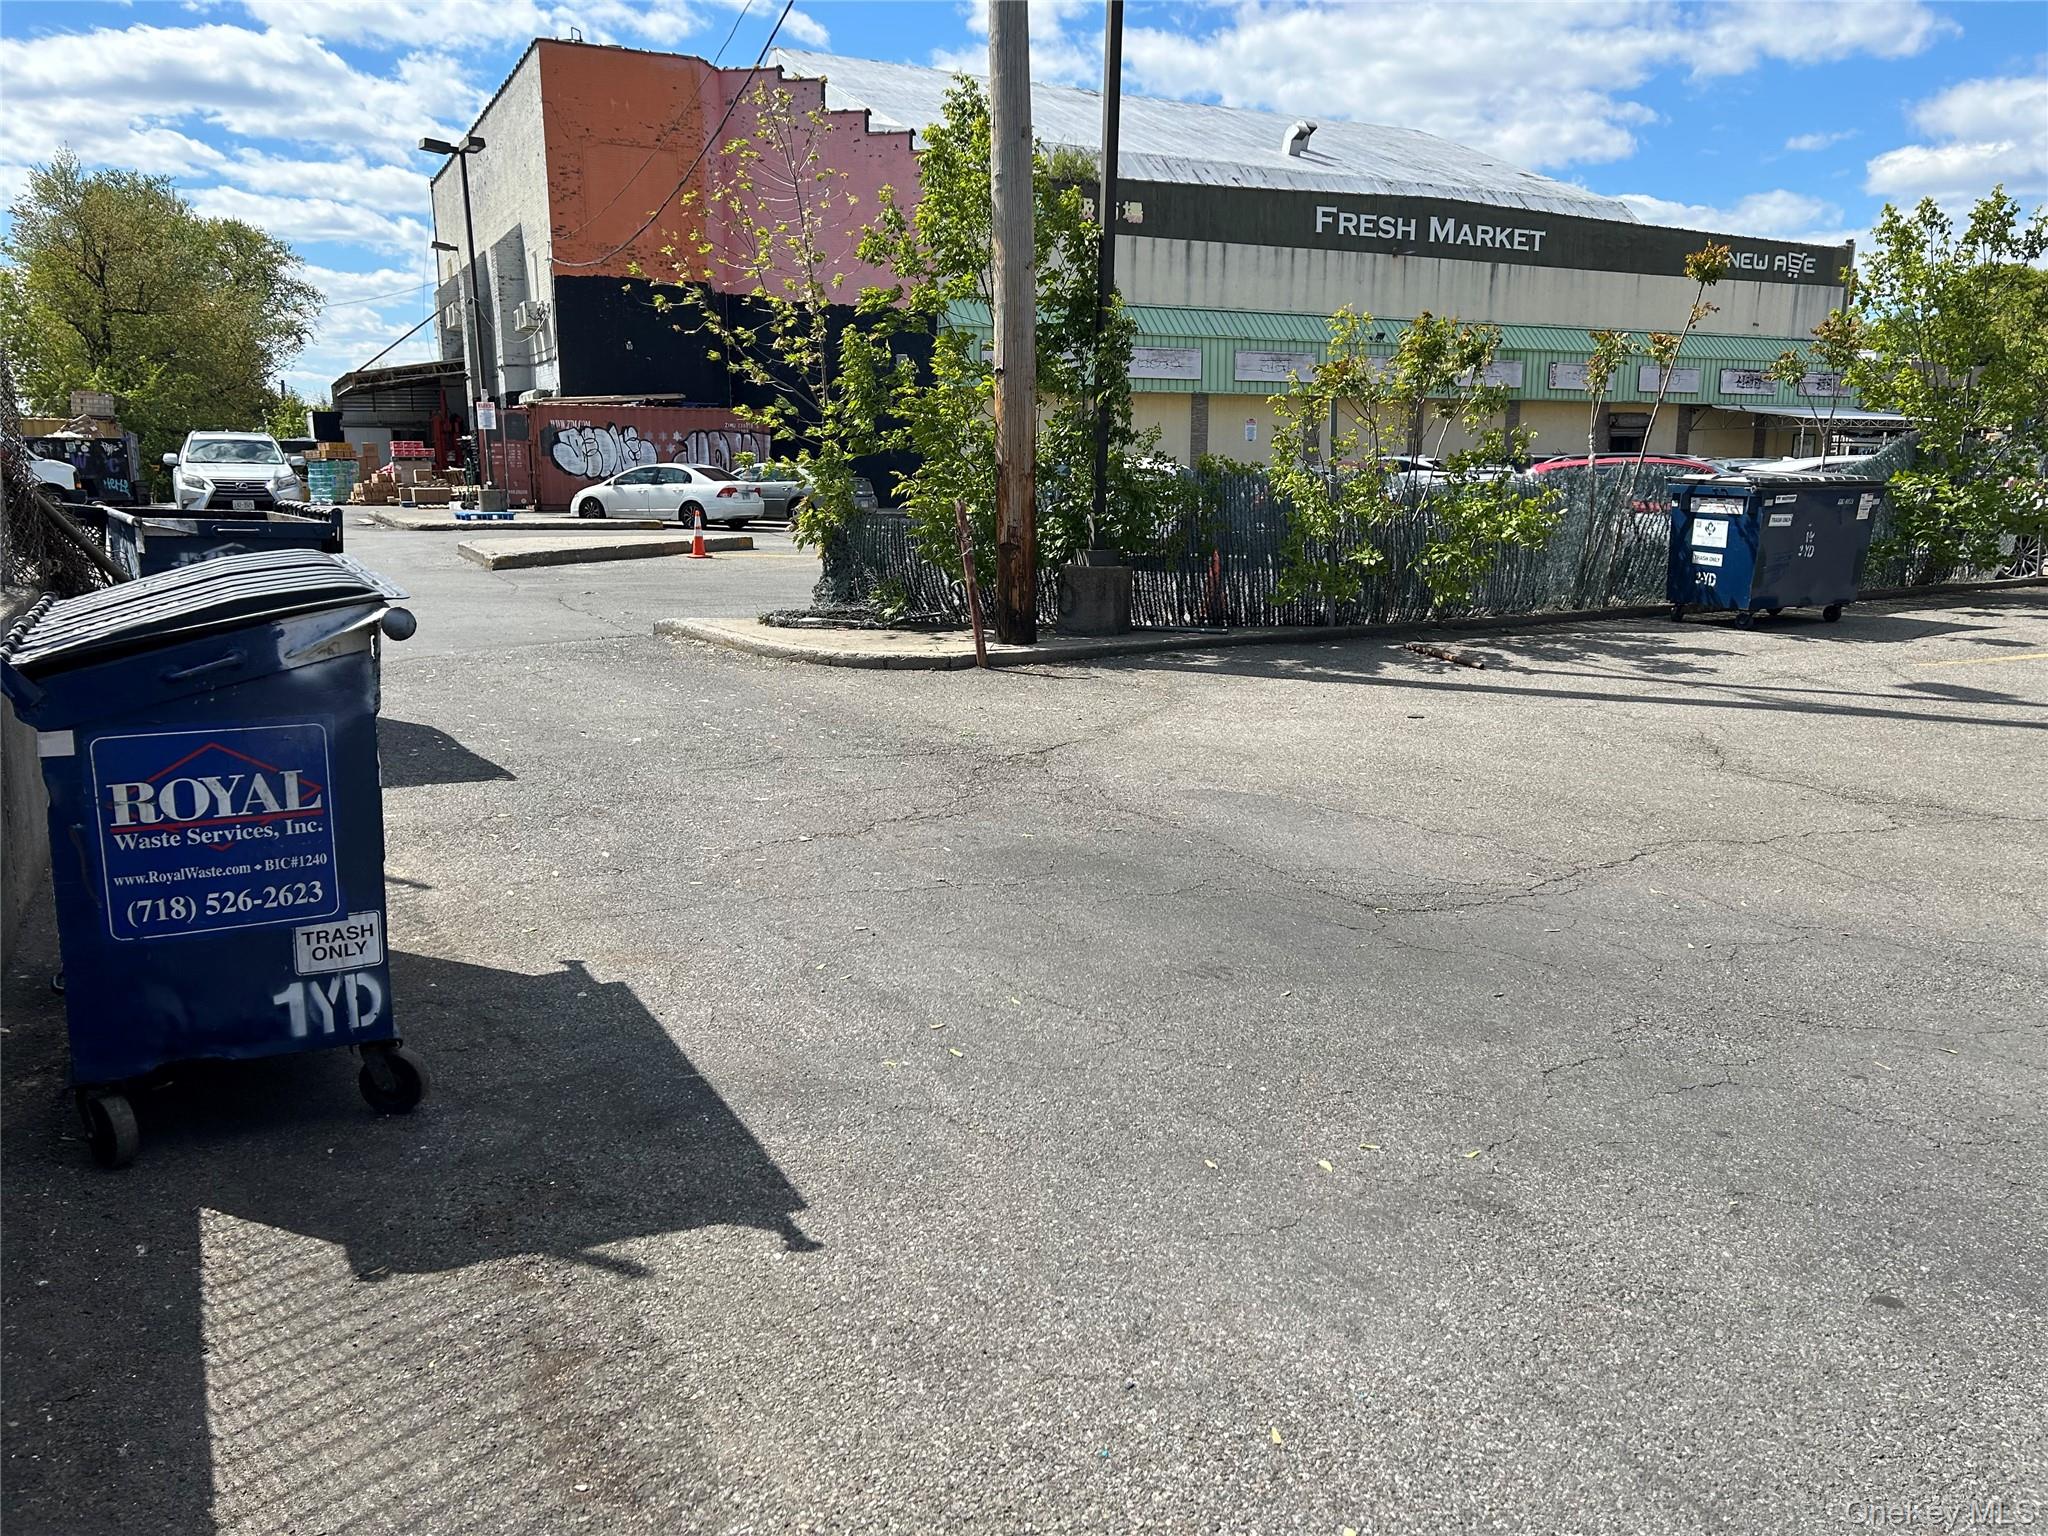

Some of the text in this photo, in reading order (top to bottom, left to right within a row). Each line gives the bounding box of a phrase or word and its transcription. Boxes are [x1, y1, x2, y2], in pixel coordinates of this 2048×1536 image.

[1315, 206, 1547, 252] FRESH MARKET
[1727, 252, 1768, 270] NEW
[106, 770, 322, 827] ROYAL
[113, 819, 324, 851] Waste Services, Inc.
[113, 853, 327, 887] www.RoyalWaste.com BIC#1240
[126, 880, 324, 928] (718) 526-2623
[301, 923, 375, 946] TRASH
[311, 940, 368, 962] ONLY
[273, 973, 383, 1037] 1YD
